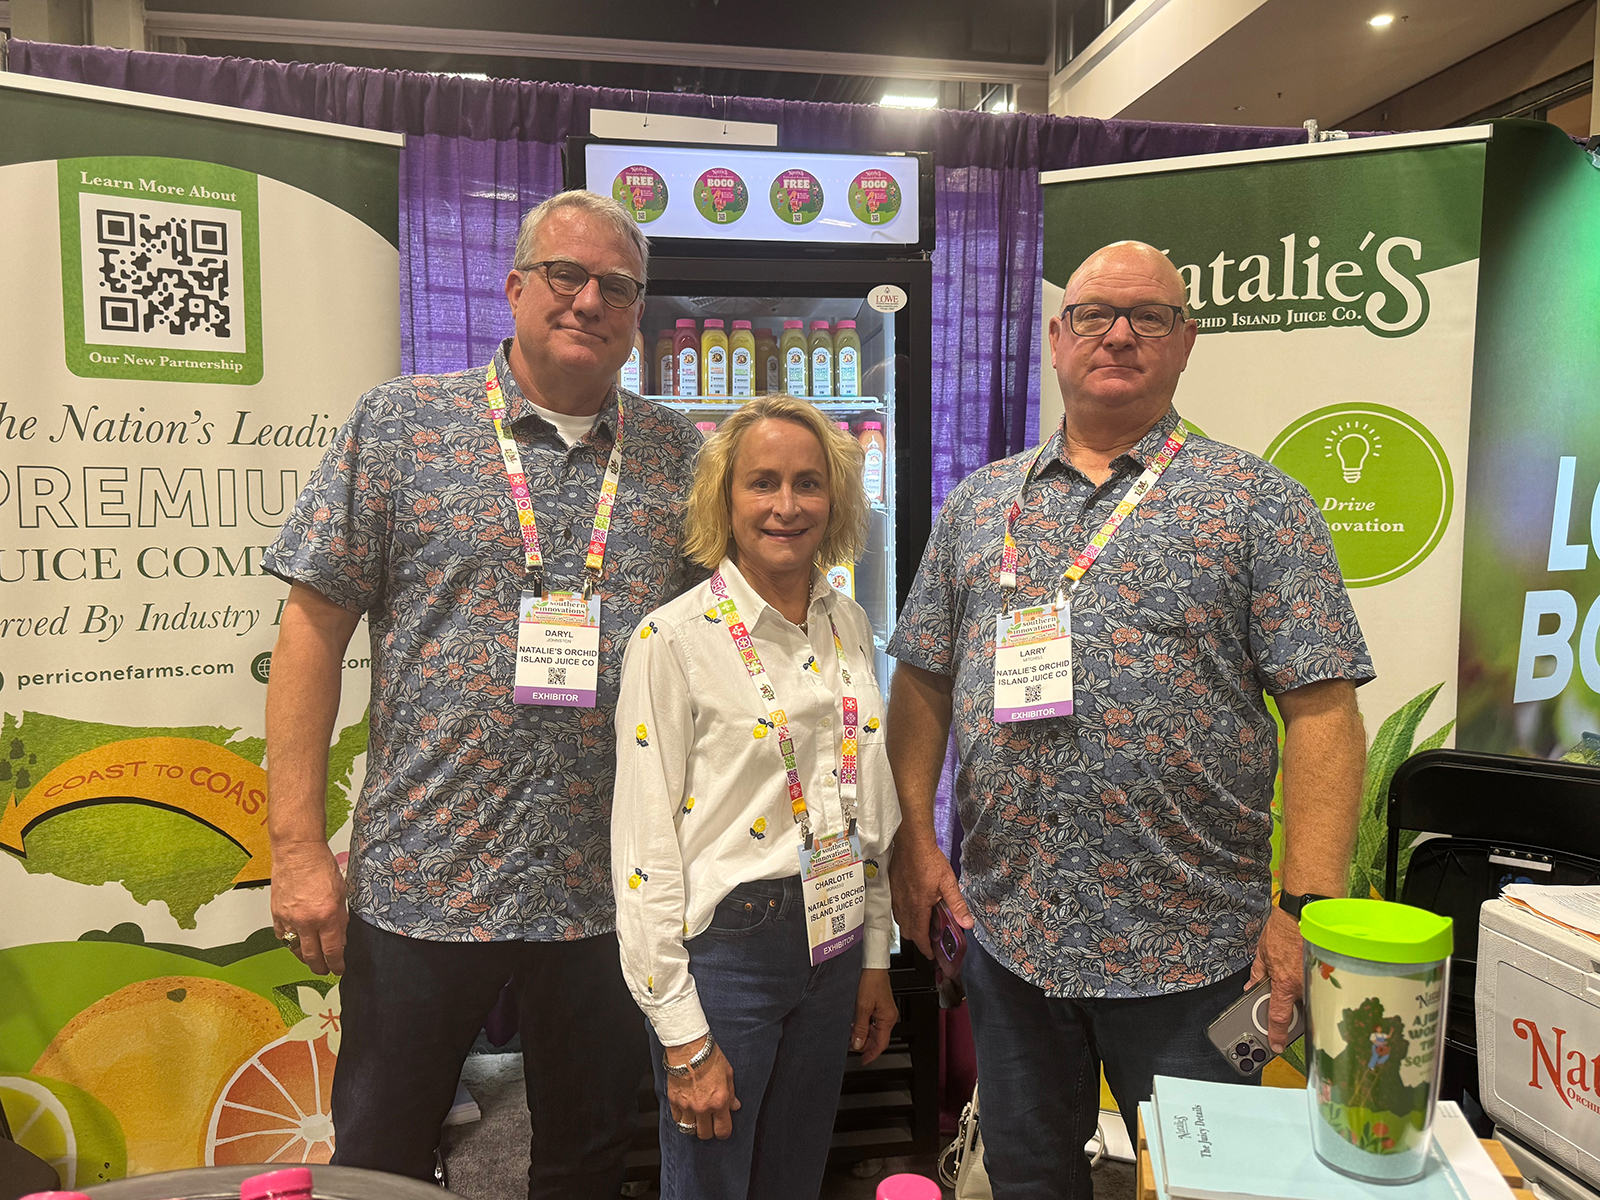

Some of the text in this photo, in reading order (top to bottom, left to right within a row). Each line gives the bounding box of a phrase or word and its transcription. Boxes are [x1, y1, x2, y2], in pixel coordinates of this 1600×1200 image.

[80, 171, 237, 203] Learn More About
[626, 175, 654, 186] FREE
[783, 179, 811, 189] FREE
[1161, 231, 1423, 332] atalie'S
[875, 295, 899, 303] LOWE
[88, 351, 244, 374] Our New Partnership
[49, 403, 215, 446] Nation's
[0, 465, 299, 529] REMIU
[1322, 497, 1376, 511] Drive
[1327, 517, 1405, 532] ovation
[79, 604, 125, 643] By
[135, 601, 261, 637] Industry
[545, 629, 574, 639] DARYL
[519, 645, 598, 658] NATALIE'S ORCHID
[1019, 646, 1047, 658] LARRY
[520, 655, 595, 667] ISLAND JUICE CO
[996, 659, 1071, 677] NATALIE'S ORCHID
[18, 661, 234, 690] perriconefarms.com
[998, 669, 1068, 686] ISLAND JUICE CO
[532, 691, 579, 702] EXHIBITOR
[1011, 707, 1056, 720] EXHIBITOR
[44, 761, 268, 826] COAST TO COAS
[815, 870, 854, 891] CHARLOTTE
[807, 894, 840, 914] NATALIE'S
[840, 885, 866, 900] ORCHID
[810, 895, 864, 923] ISLAND JUICE CO
[822, 934, 855, 956] EXHIBITOR
[1191, 1104, 1206, 1127] Details
[1200, 1144, 1212, 1158] The
